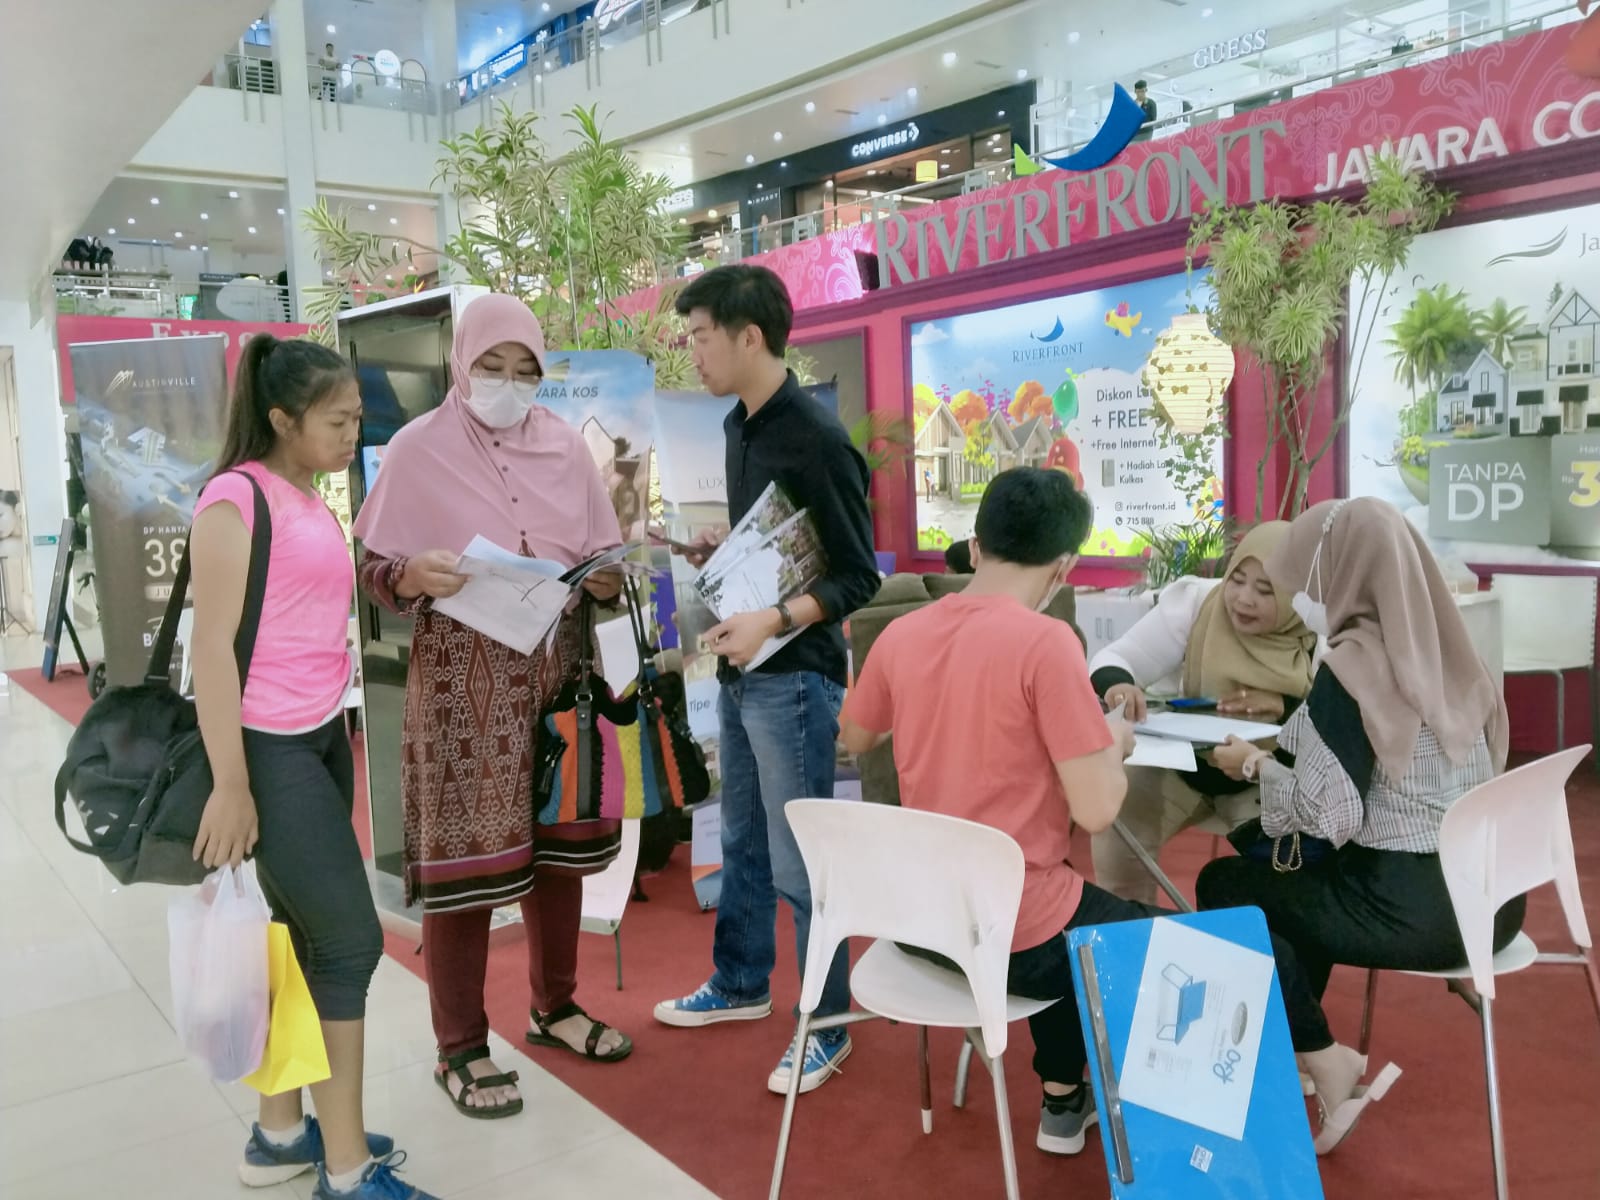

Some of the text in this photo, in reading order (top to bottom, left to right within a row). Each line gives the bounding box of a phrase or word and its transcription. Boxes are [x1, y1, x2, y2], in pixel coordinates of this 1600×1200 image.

[1193, 29, 1266, 69] GUESS
[851, 129, 908, 157] CONVERSE
[1314, 117, 1509, 193] JAWARA
[875, 120, 1286, 289] RIVERFRONT
[1011, 342, 1084, 363] RIVERFRONT
[573, 386, 599, 398] KOS
[1096, 388, 1132, 402] Diskon
[1108, 408, 1148, 429] FREE
[1120, 438, 1157, 449] Internet
[1126, 460, 1155, 470] Hadiah
[1444, 461, 1526, 481] TANPA
[1119, 475, 1144, 484] Kulkas
[1569, 461, 1600, 507] 3
[1126, 502, 1176, 511] riverfront.id
[1448, 482, 1524, 521] DP
[689, 699, 711, 713] Tipe
